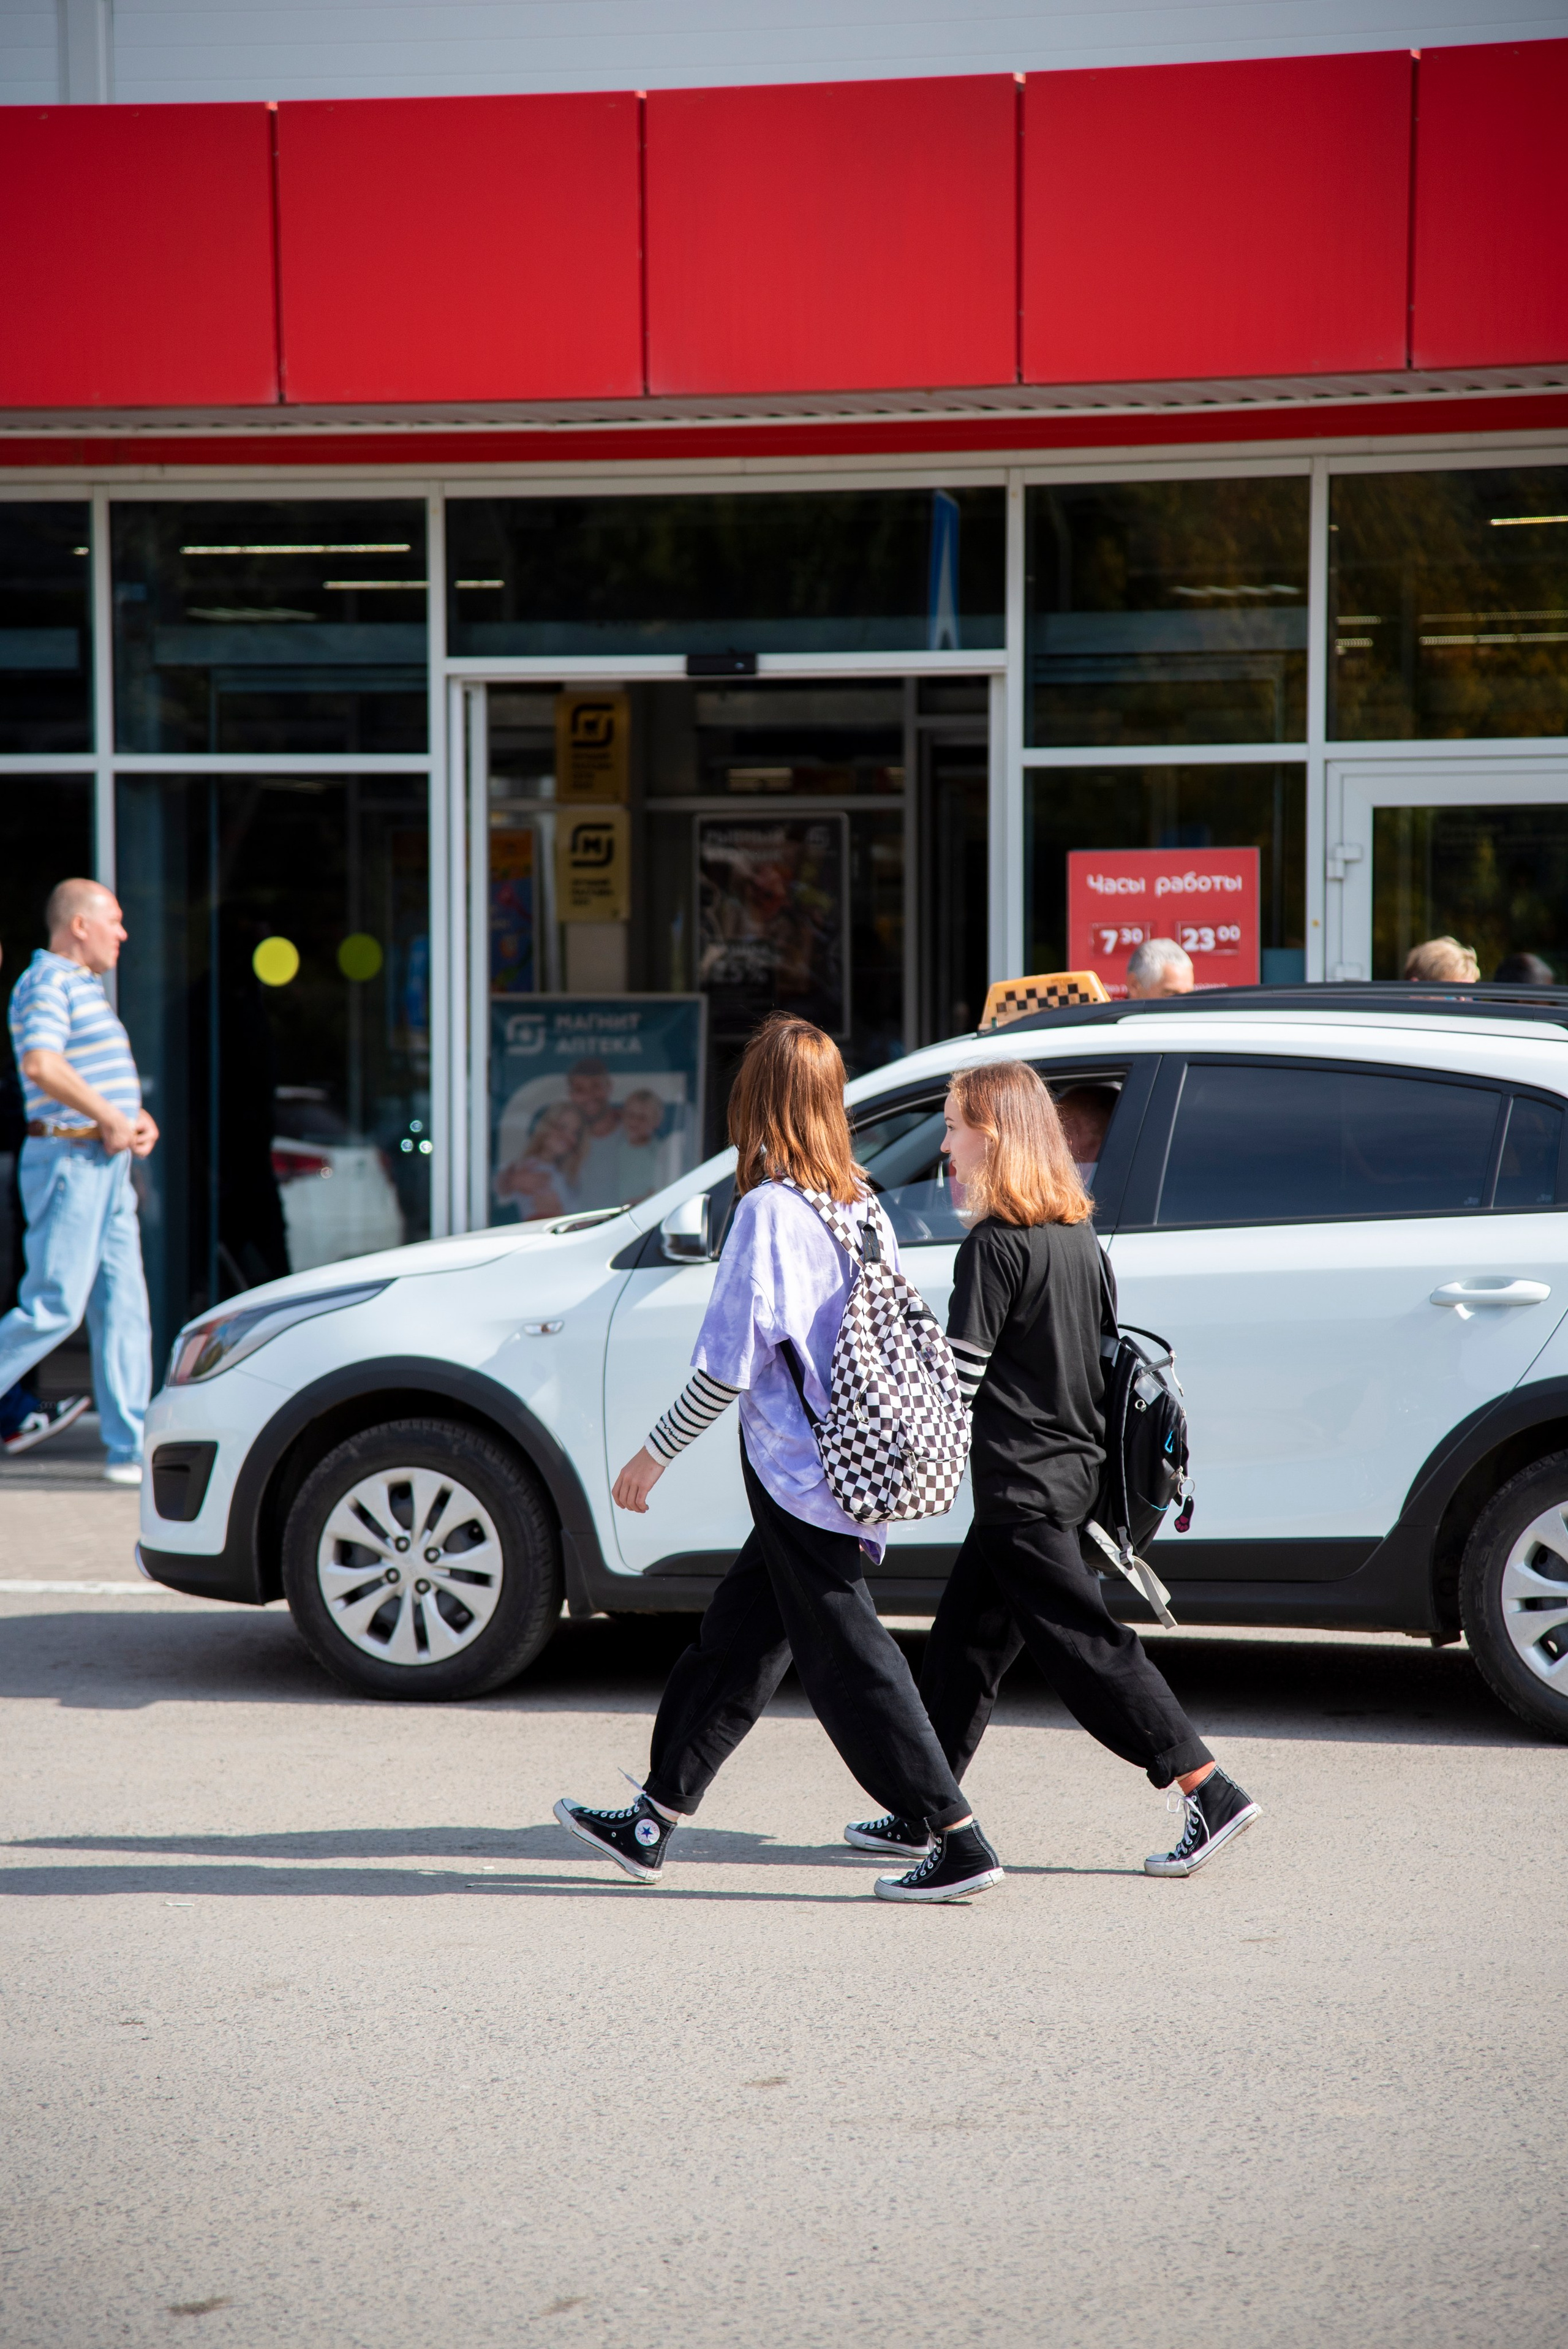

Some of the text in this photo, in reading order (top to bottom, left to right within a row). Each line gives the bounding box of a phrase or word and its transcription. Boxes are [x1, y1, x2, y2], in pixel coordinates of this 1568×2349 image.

[1087, 871, 1242, 898] Часы работы
[556, 1035, 642, 1055] АПТЕКА
